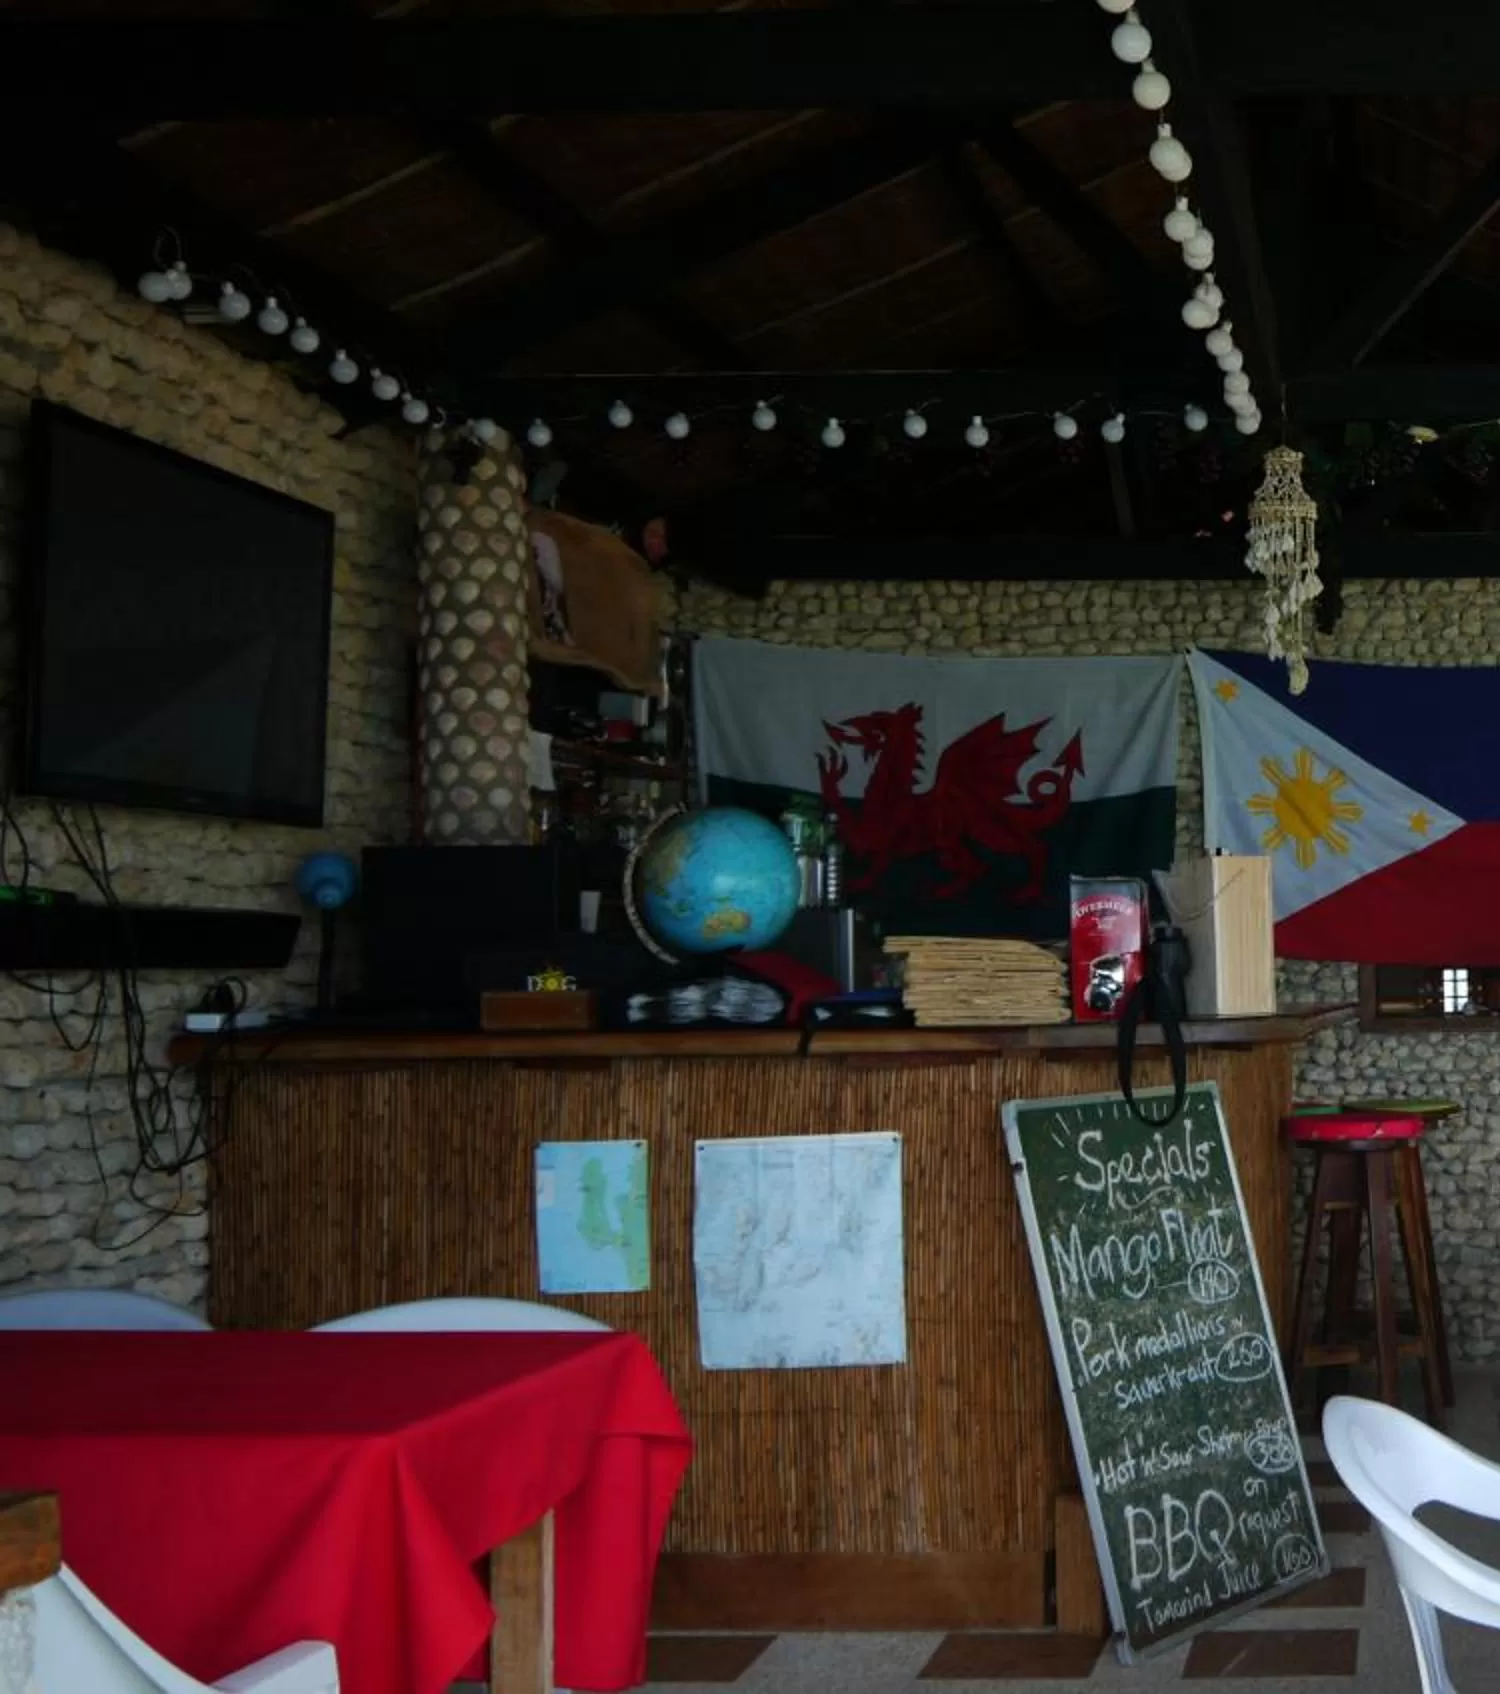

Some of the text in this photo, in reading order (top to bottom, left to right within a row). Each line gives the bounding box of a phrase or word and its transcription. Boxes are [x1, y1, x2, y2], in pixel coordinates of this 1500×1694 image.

[1075, 1119, 1216, 1207] Specials
[1051, 1196, 1233, 1300] Mango Float
[1072, 1316, 1131, 1384] Pork
[1135, 1309, 1226, 1360] medallions
[1100, 1437, 1136, 1493] Hot
[1124, 1488, 1238, 1592] BBQ
